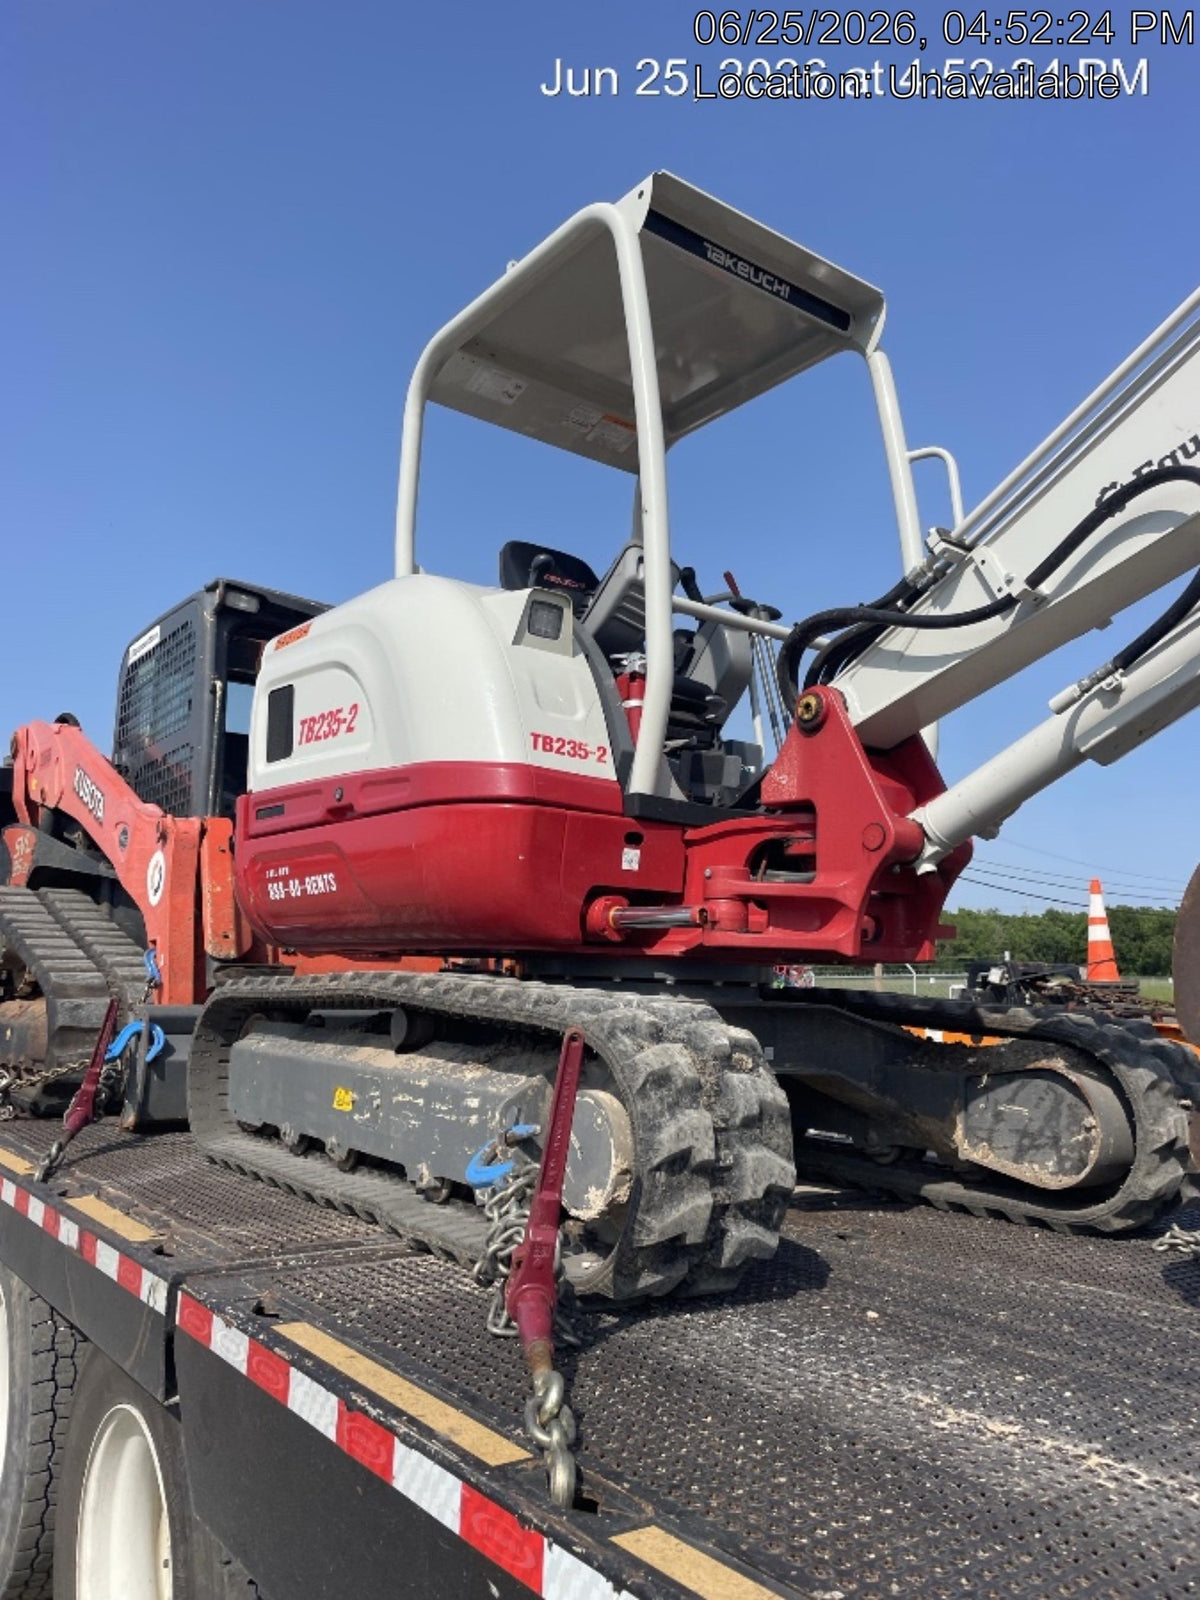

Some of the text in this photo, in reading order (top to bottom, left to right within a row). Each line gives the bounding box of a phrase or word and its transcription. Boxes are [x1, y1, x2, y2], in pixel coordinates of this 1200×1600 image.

[703, 242, 791, 300] TAKEUCHI
[298, 703, 359, 746] TB235-2
[530, 731, 608, 764] TB235-2
